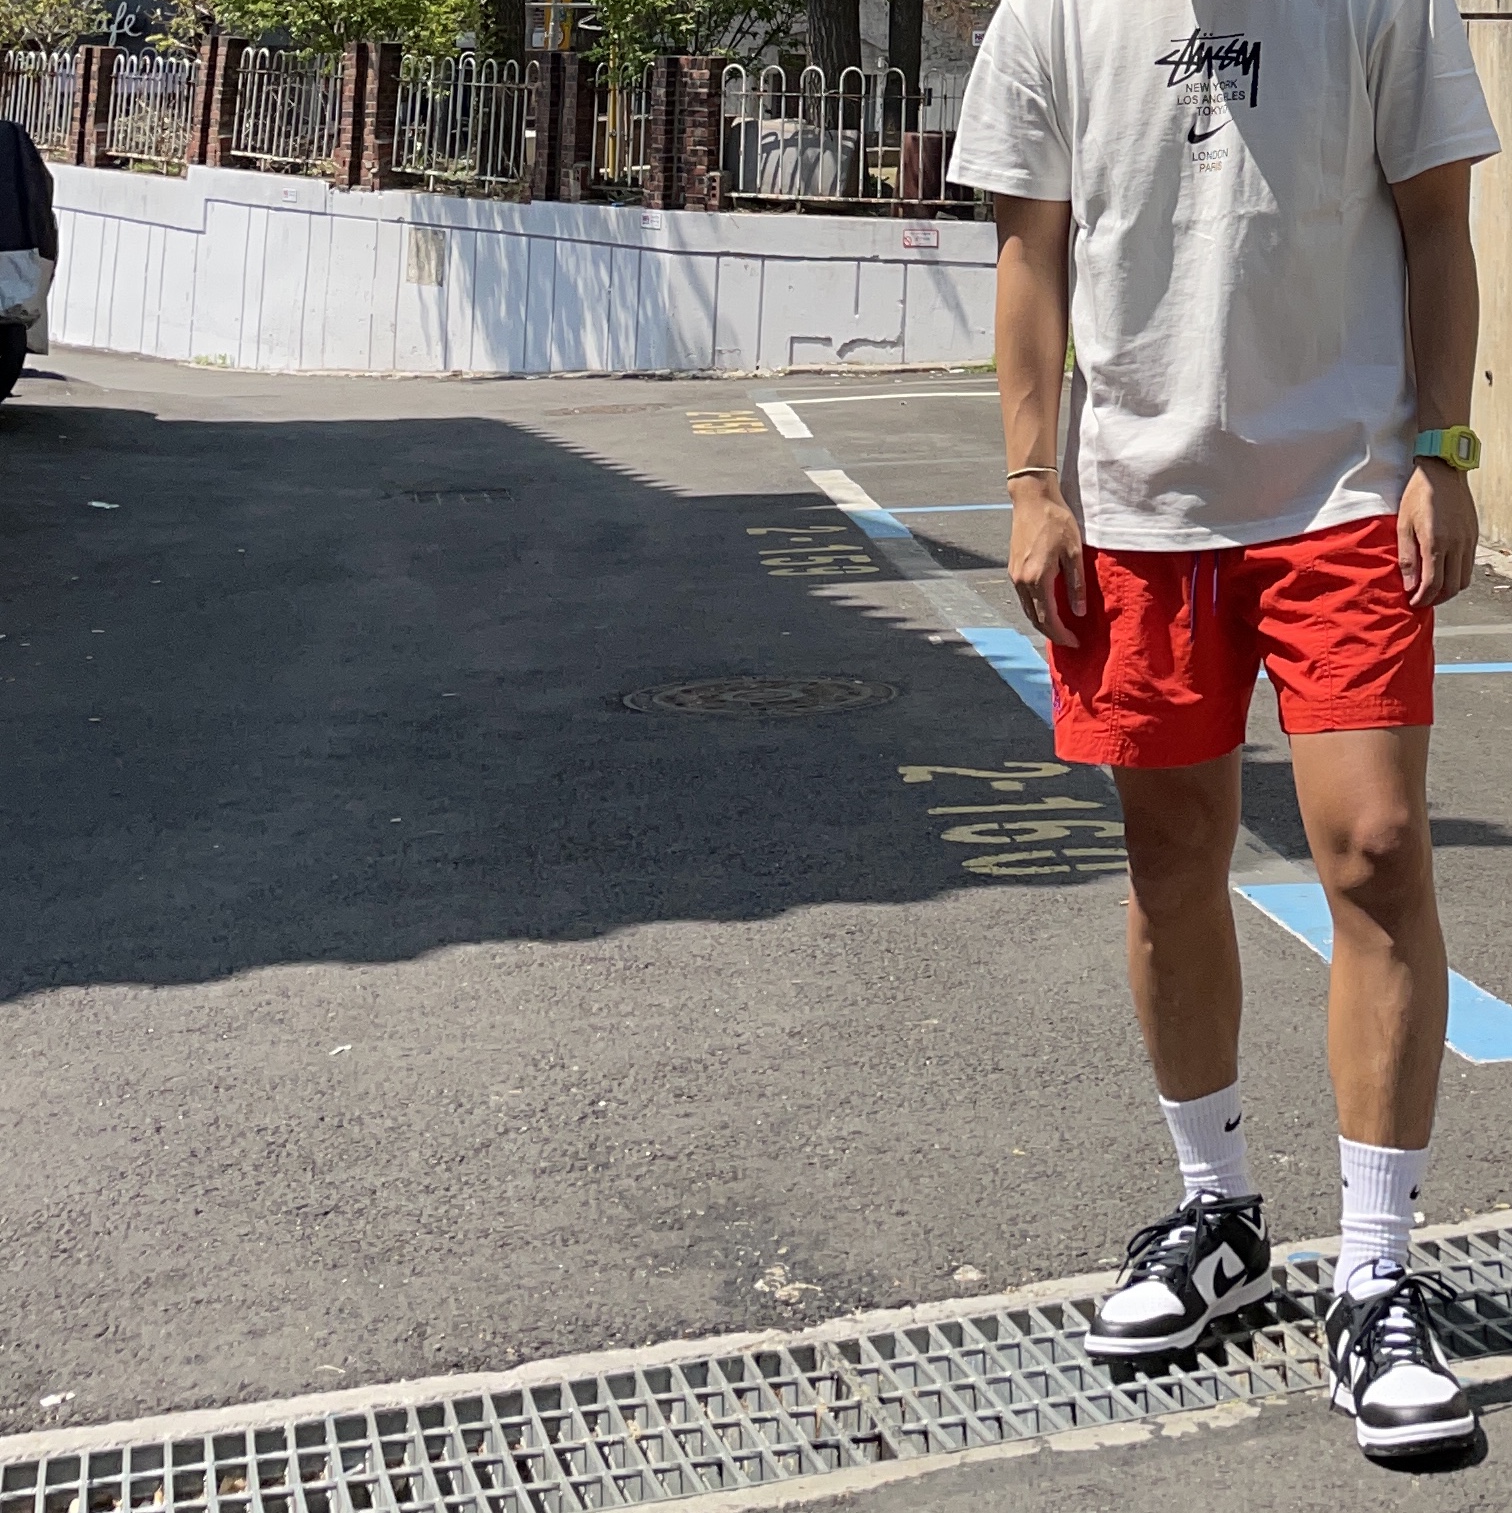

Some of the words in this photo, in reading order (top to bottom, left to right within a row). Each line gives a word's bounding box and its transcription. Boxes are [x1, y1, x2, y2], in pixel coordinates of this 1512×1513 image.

[1185, 82, 1210, 93] NEW
[1212, 79, 1238, 90] YORK
[1177, 94, 1199, 105] LOS
[1201, 90, 1246, 104] ANGELES
